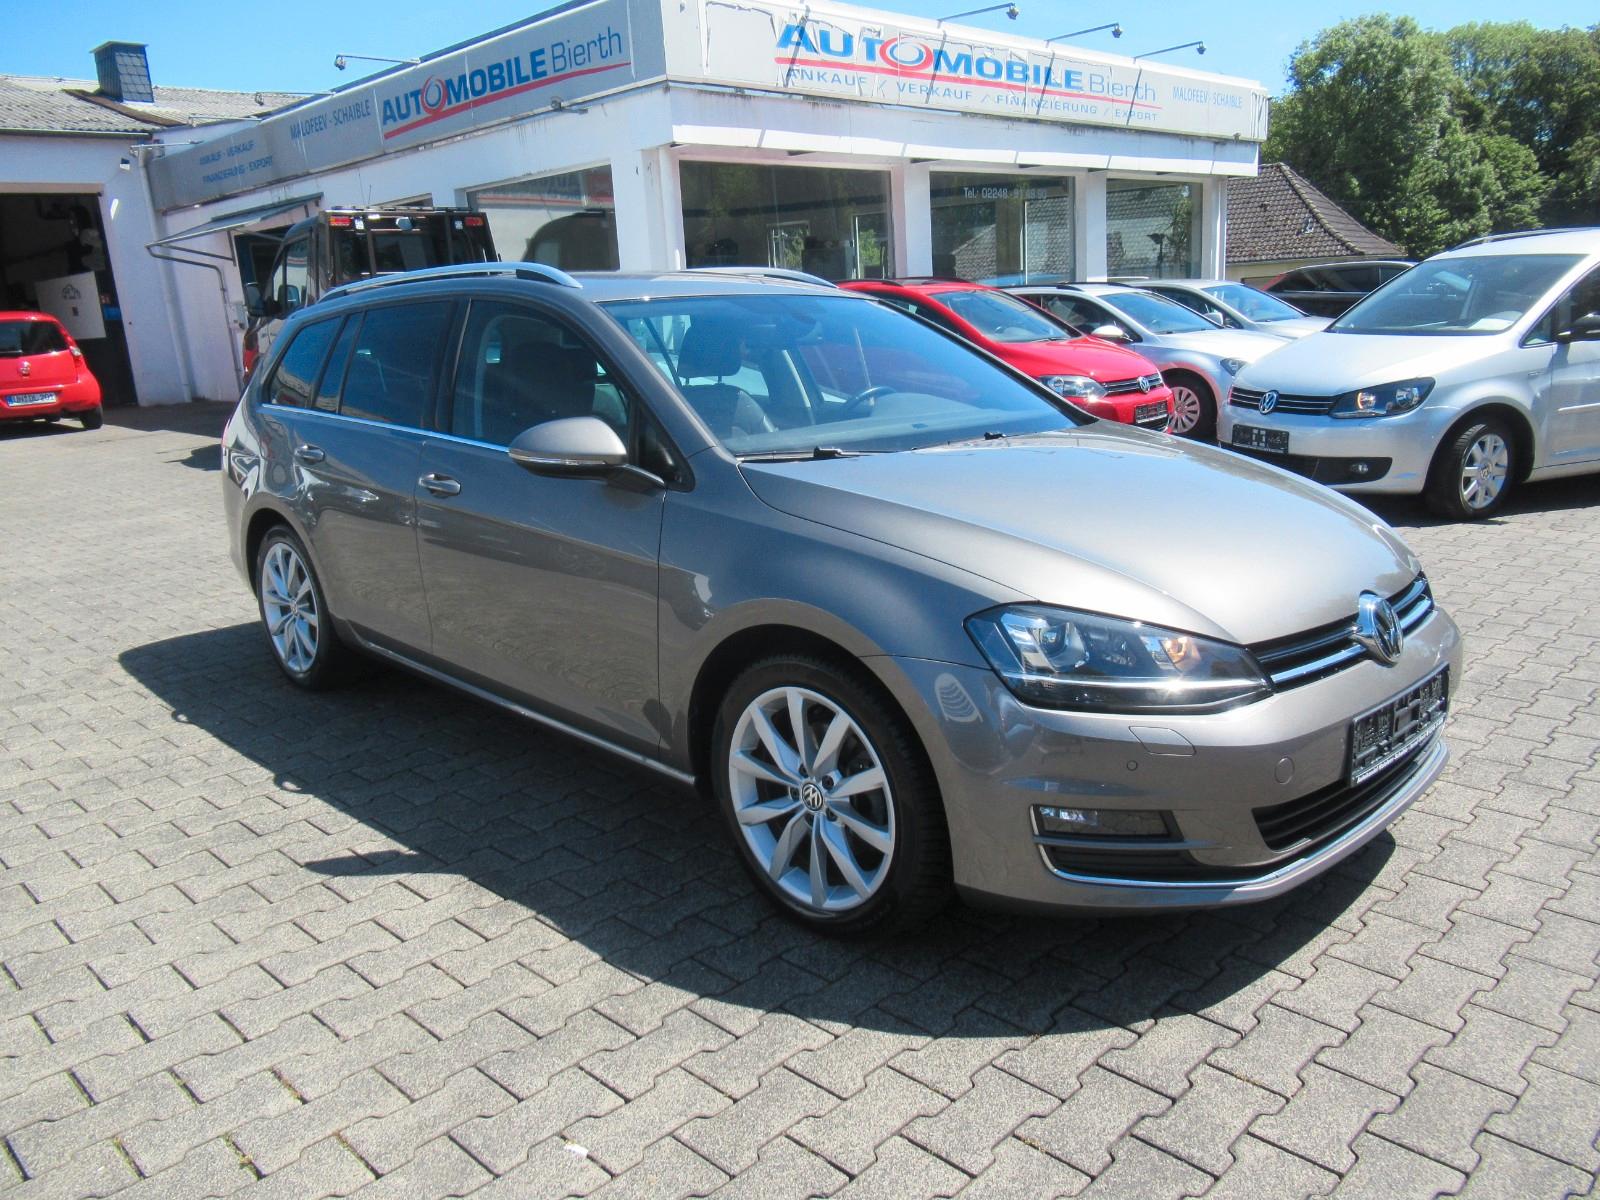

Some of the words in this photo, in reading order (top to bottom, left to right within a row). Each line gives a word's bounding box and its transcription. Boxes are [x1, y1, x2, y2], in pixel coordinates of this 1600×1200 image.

[382, 48, 547, 126] AUTOMOBILE
[551, 25, 622, 74] Bierth
[776, 23, 1085, 92] AUTOMOBILE
[1089, 73, 1156, 102] Bierth
[290, 113, 328, 140] MALOFEEV
[333, 100, 371, 127] SCHAIBLE
[788, 68, 867, 87] ANKAUF
[896, 82, 973, 101] VERKAUF
[997, 95, 1097, 114] FINANZIERUNG
[1115, 109, 1158, 122] EXPORT
[1173, 85, 1209, 105] MALOFEEV
